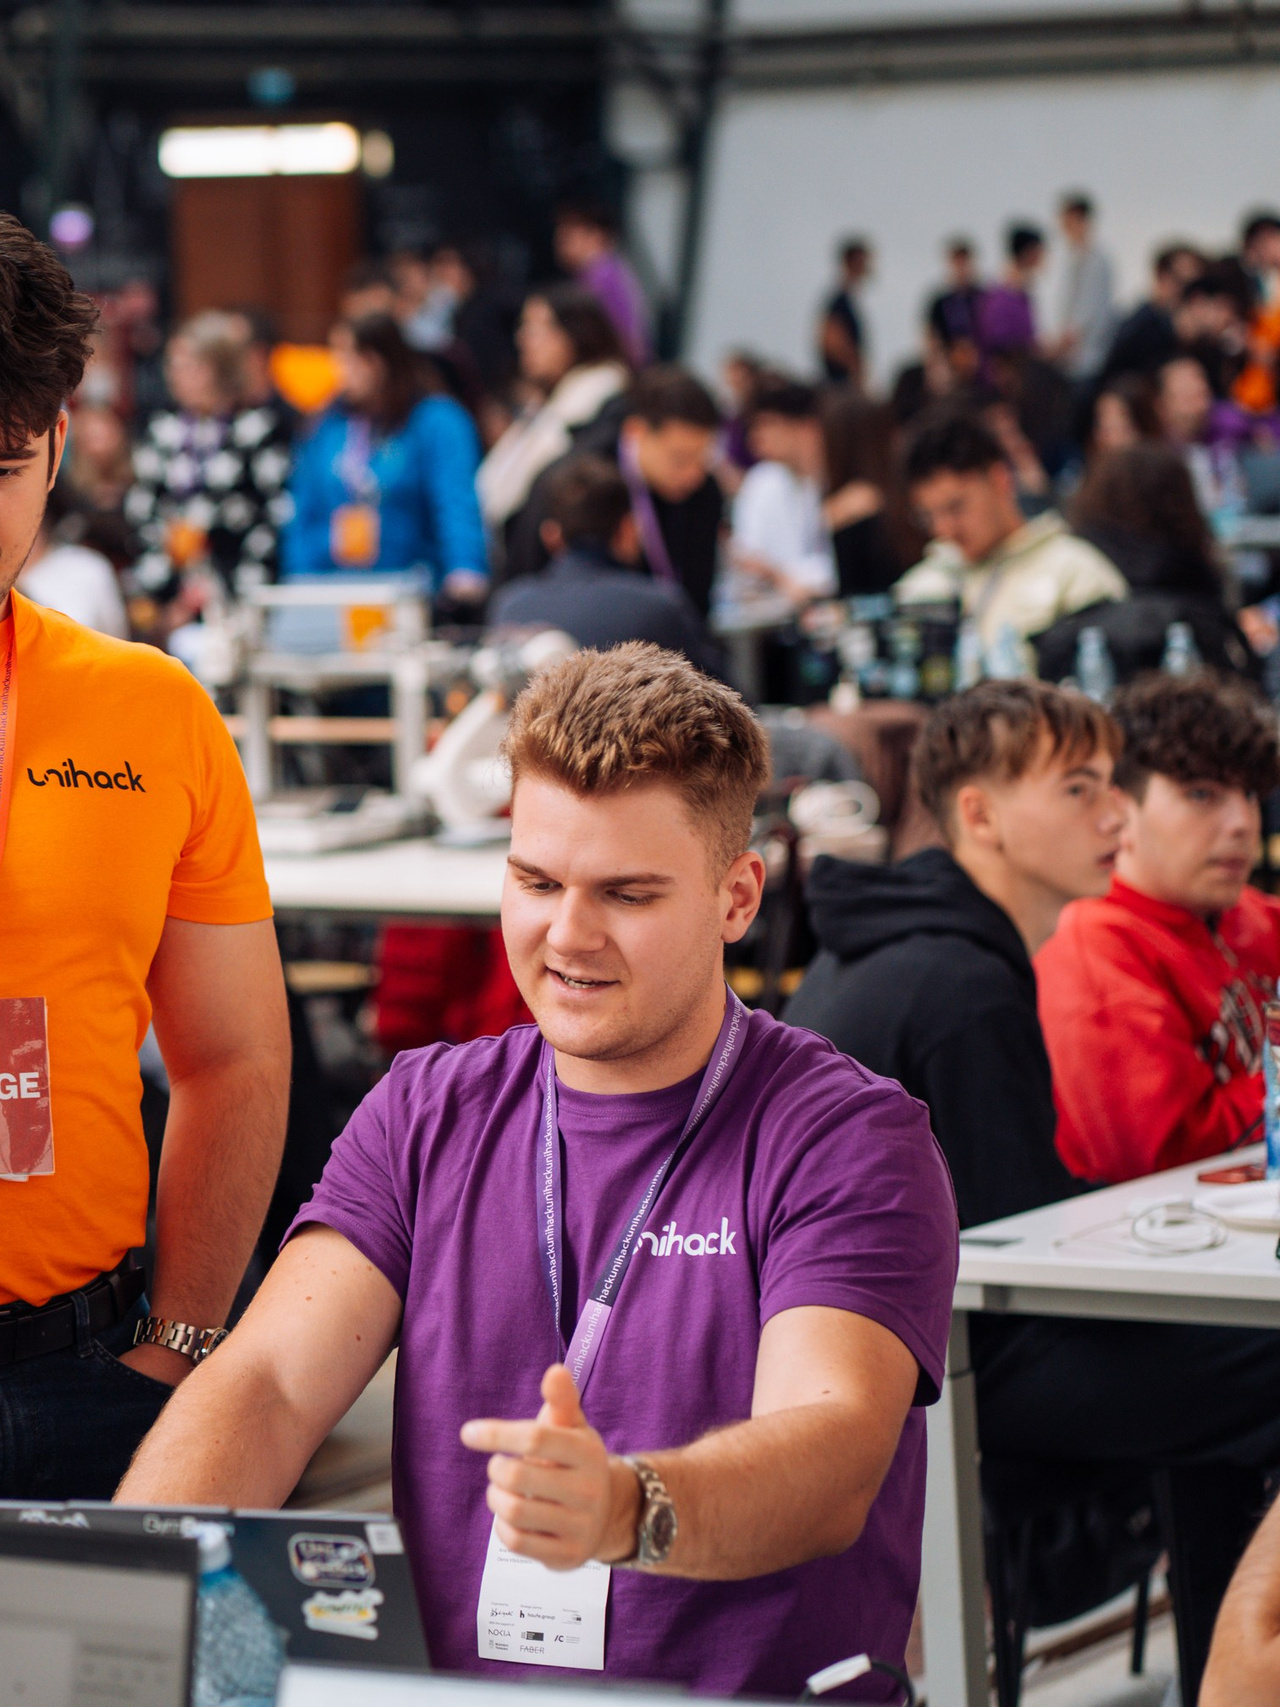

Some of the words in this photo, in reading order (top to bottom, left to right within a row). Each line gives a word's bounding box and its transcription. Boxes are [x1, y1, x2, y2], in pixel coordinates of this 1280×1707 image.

[27, 758, 146, 792] unihack
[632, 1216, 737, 1257] nihack
[520, 1645, 545, 1655] FABER
